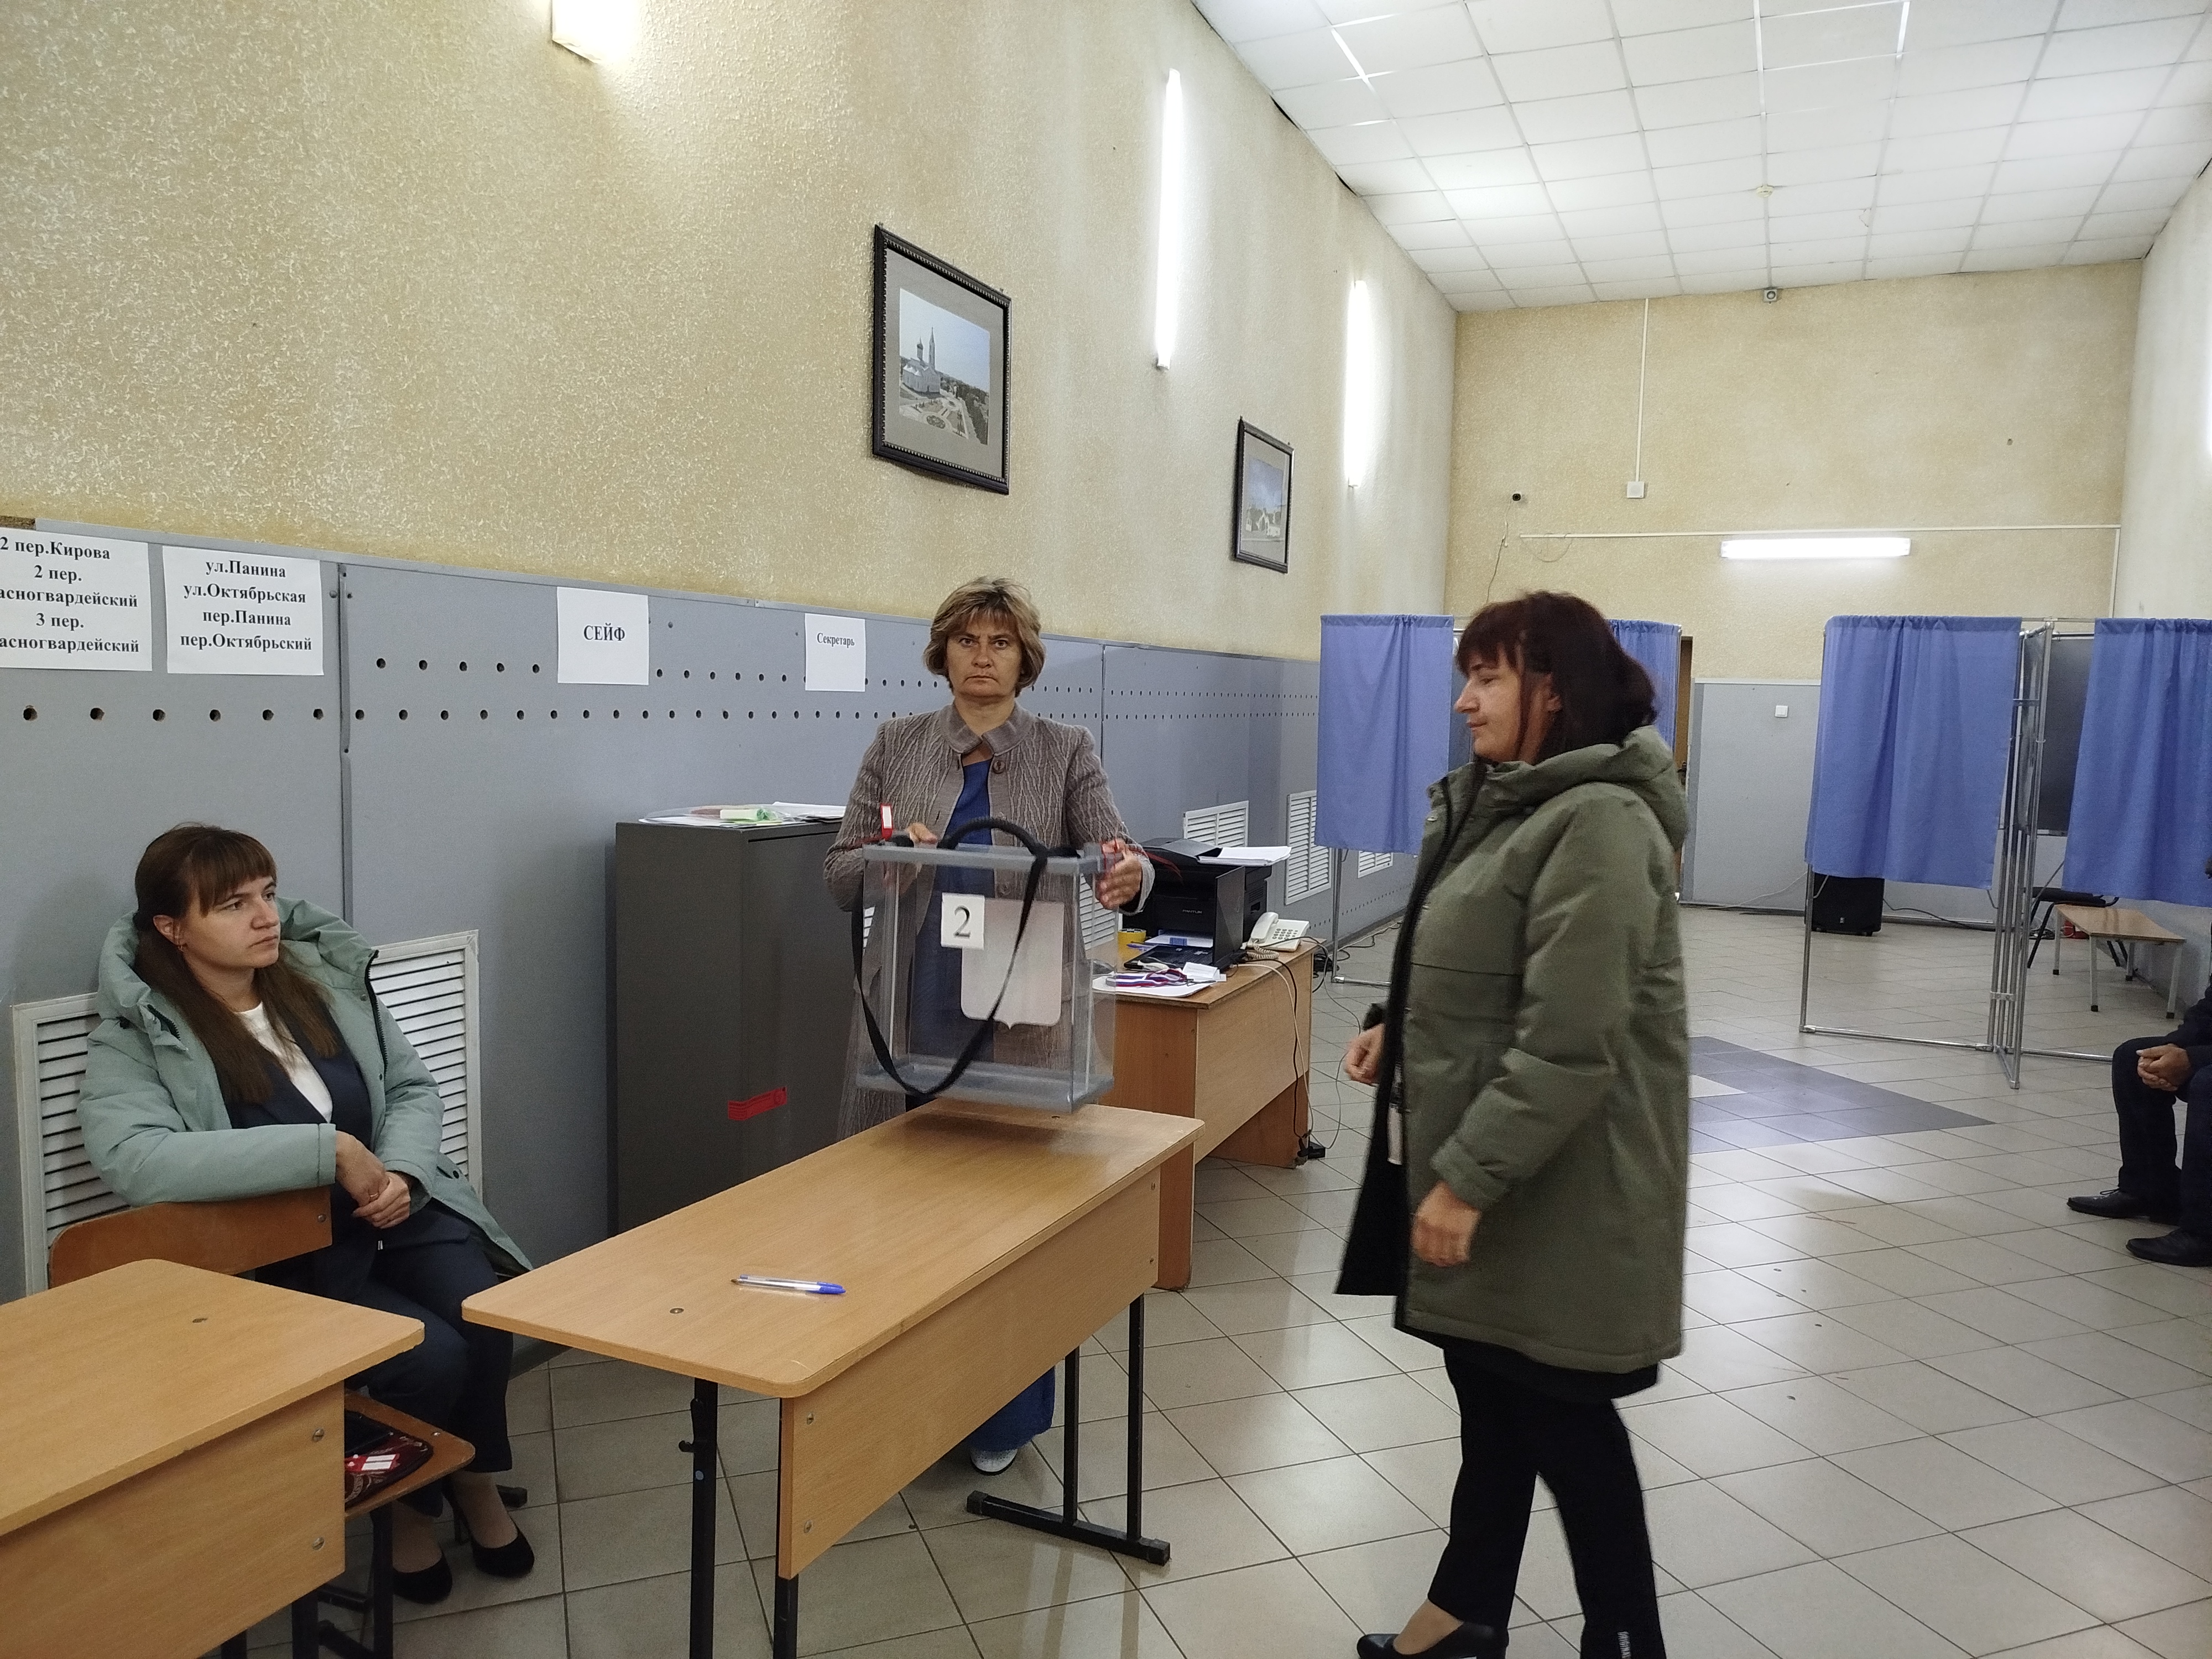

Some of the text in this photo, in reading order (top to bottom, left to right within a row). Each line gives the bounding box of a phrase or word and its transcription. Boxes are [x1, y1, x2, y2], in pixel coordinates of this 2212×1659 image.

[0, 536, 111, 561] 2 пер.Кирова
[34, 564, 82, 585] 2 пер.
[205, 560, 286, 578] ул.Панина
[183, 583, 306, 604] ул.Октябрьская
[35, 612, 85, 632] 3 пер.
[202, 610, 291, 627] пер.Панина
[583, 622, 626, 642] СЕЙФ
[816, 632, 855, 649] Секретарь
[180, 633, 312, 653] пер.Октябрьский
[953, 905, 971, 938] 2
